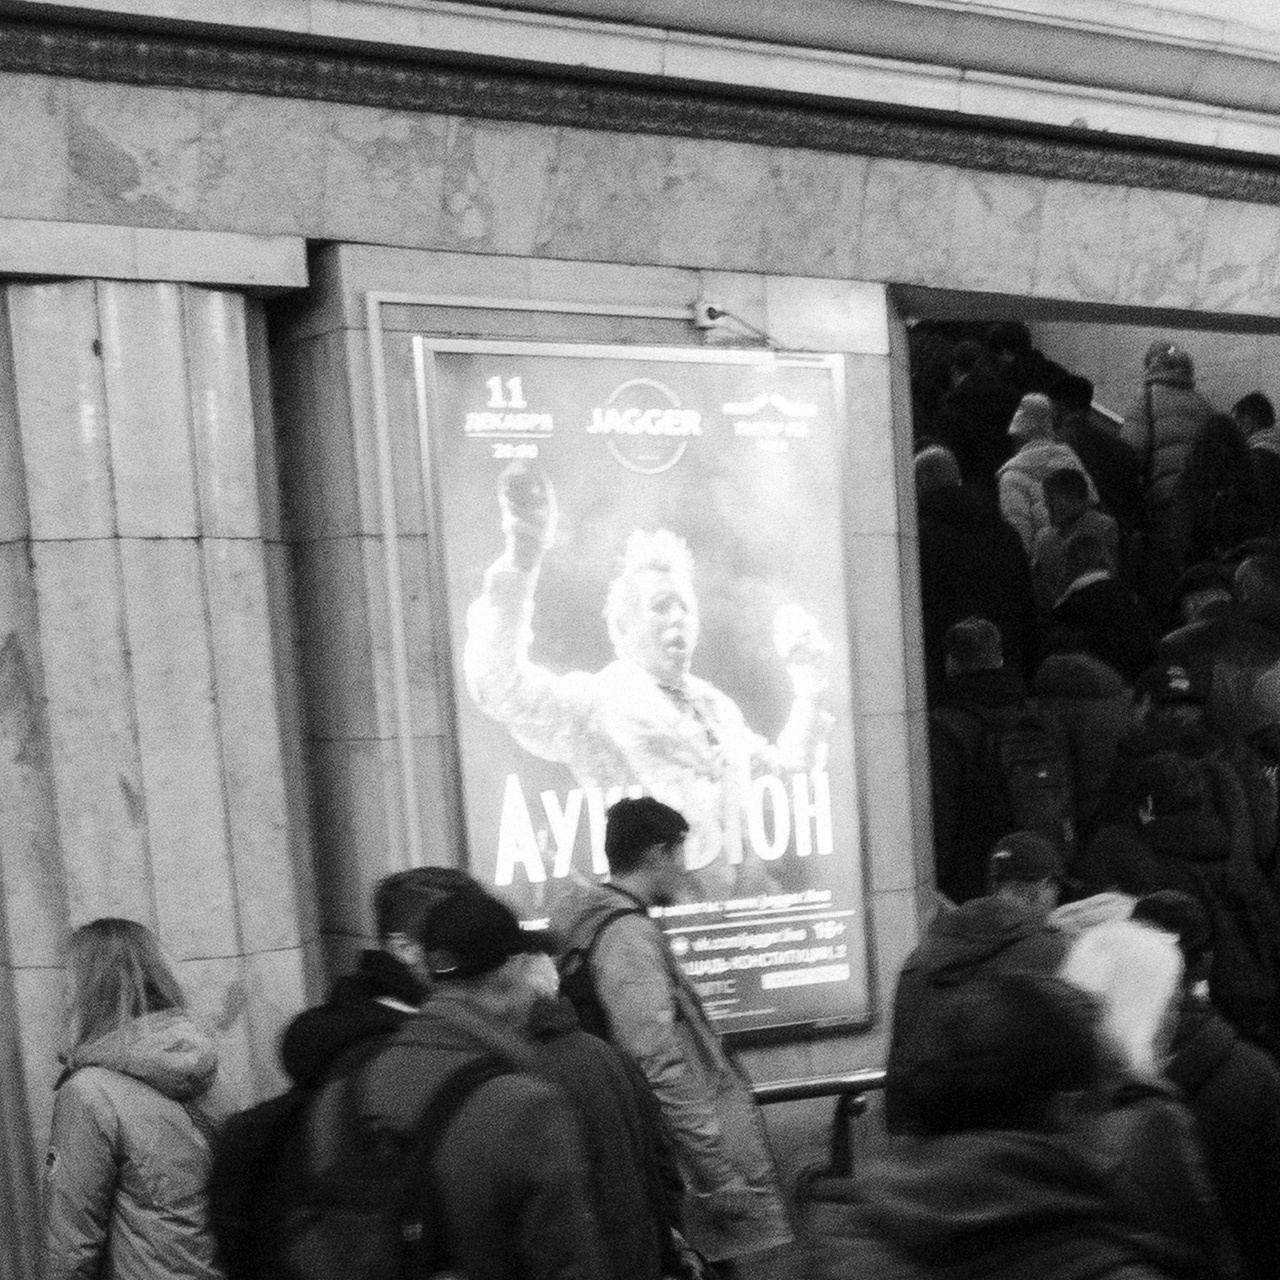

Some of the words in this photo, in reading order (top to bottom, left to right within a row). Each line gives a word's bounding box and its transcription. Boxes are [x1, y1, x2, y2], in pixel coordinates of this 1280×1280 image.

[486, 375, 527, 409] 11
[587, 407, 704, 436] JAGGER
[495, 771, 834, 886] АУЫОН
